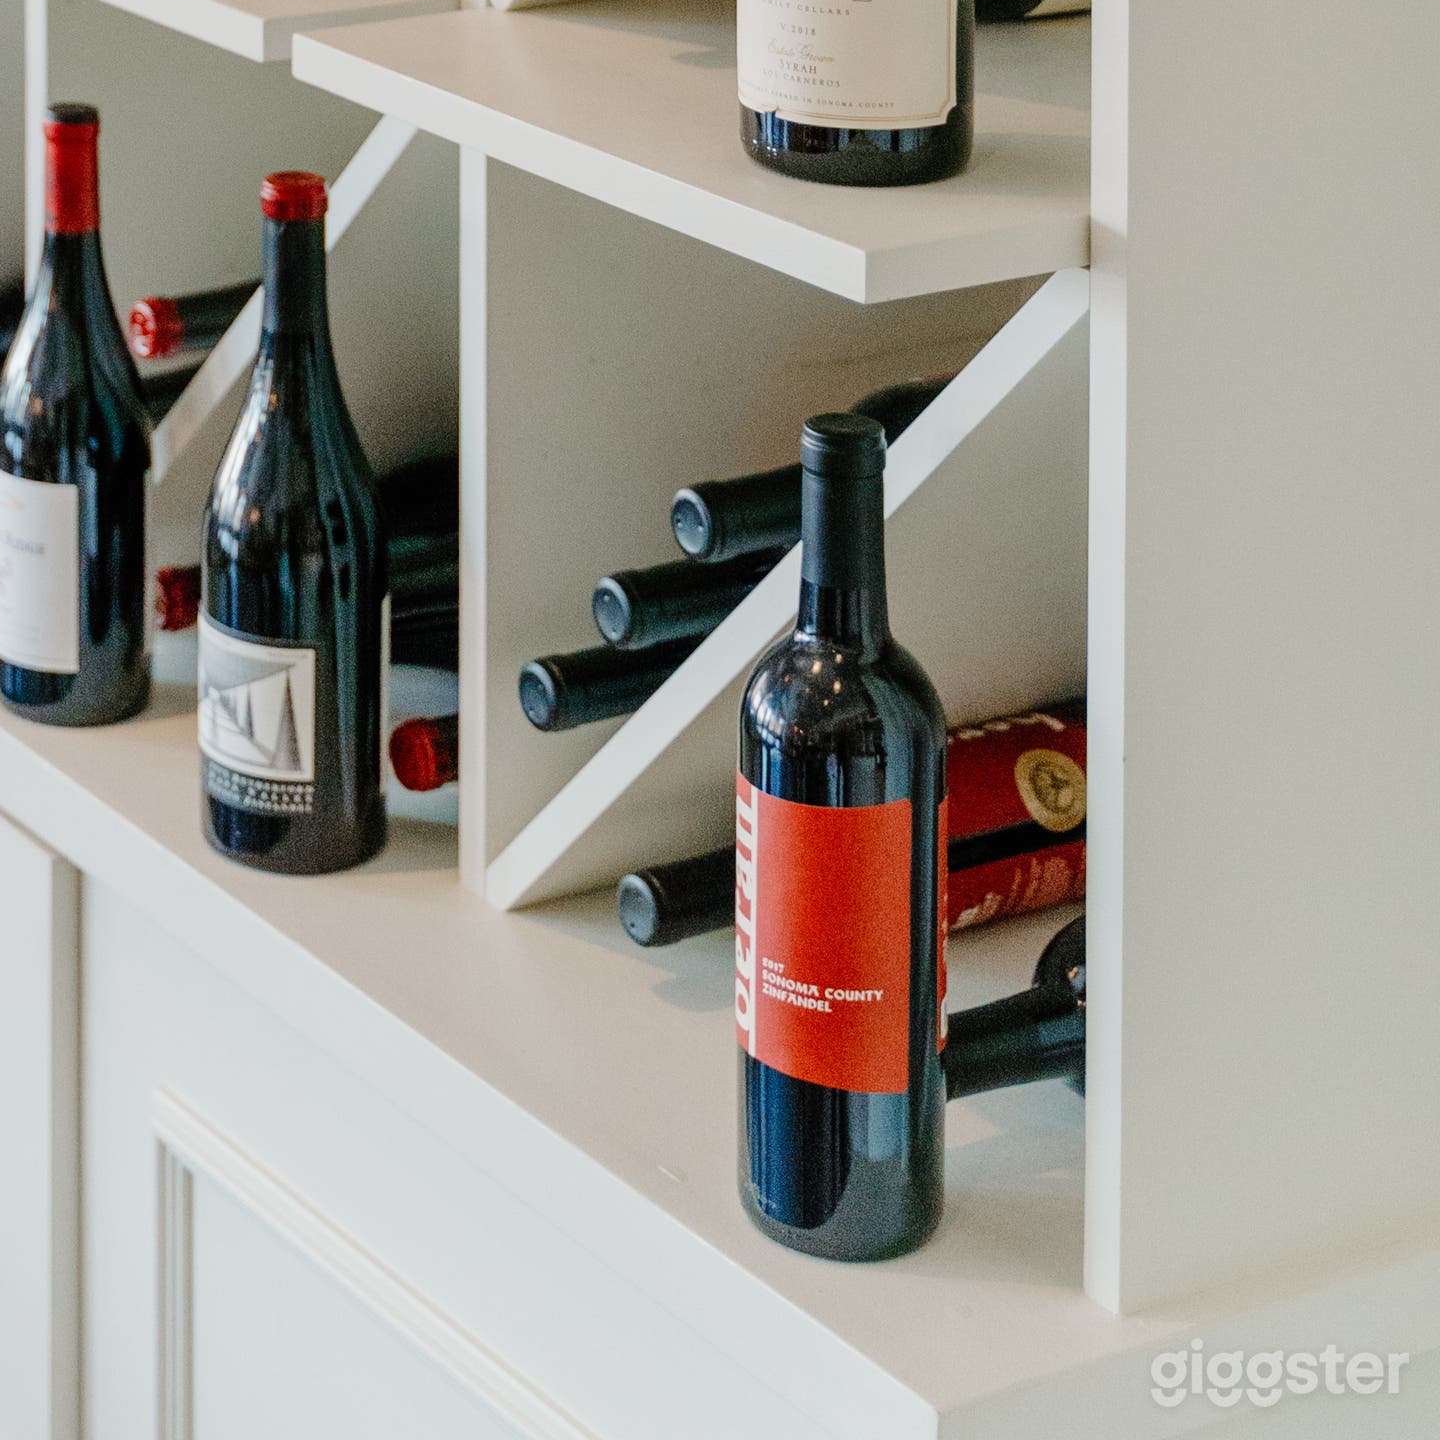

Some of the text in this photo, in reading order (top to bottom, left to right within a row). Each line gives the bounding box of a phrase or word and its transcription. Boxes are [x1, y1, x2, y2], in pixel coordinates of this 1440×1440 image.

[797, 4, 850, 16] CELLARS
[778, 59, 817, 75] SYRAH
[783, 72, 841, 88] CARNEROS
[762, 957, 785, 973] 2017
[761, 969, 884, 1002] SONOMA COUNTY
[762, 982, 833, 1013] ZINFANDEL
